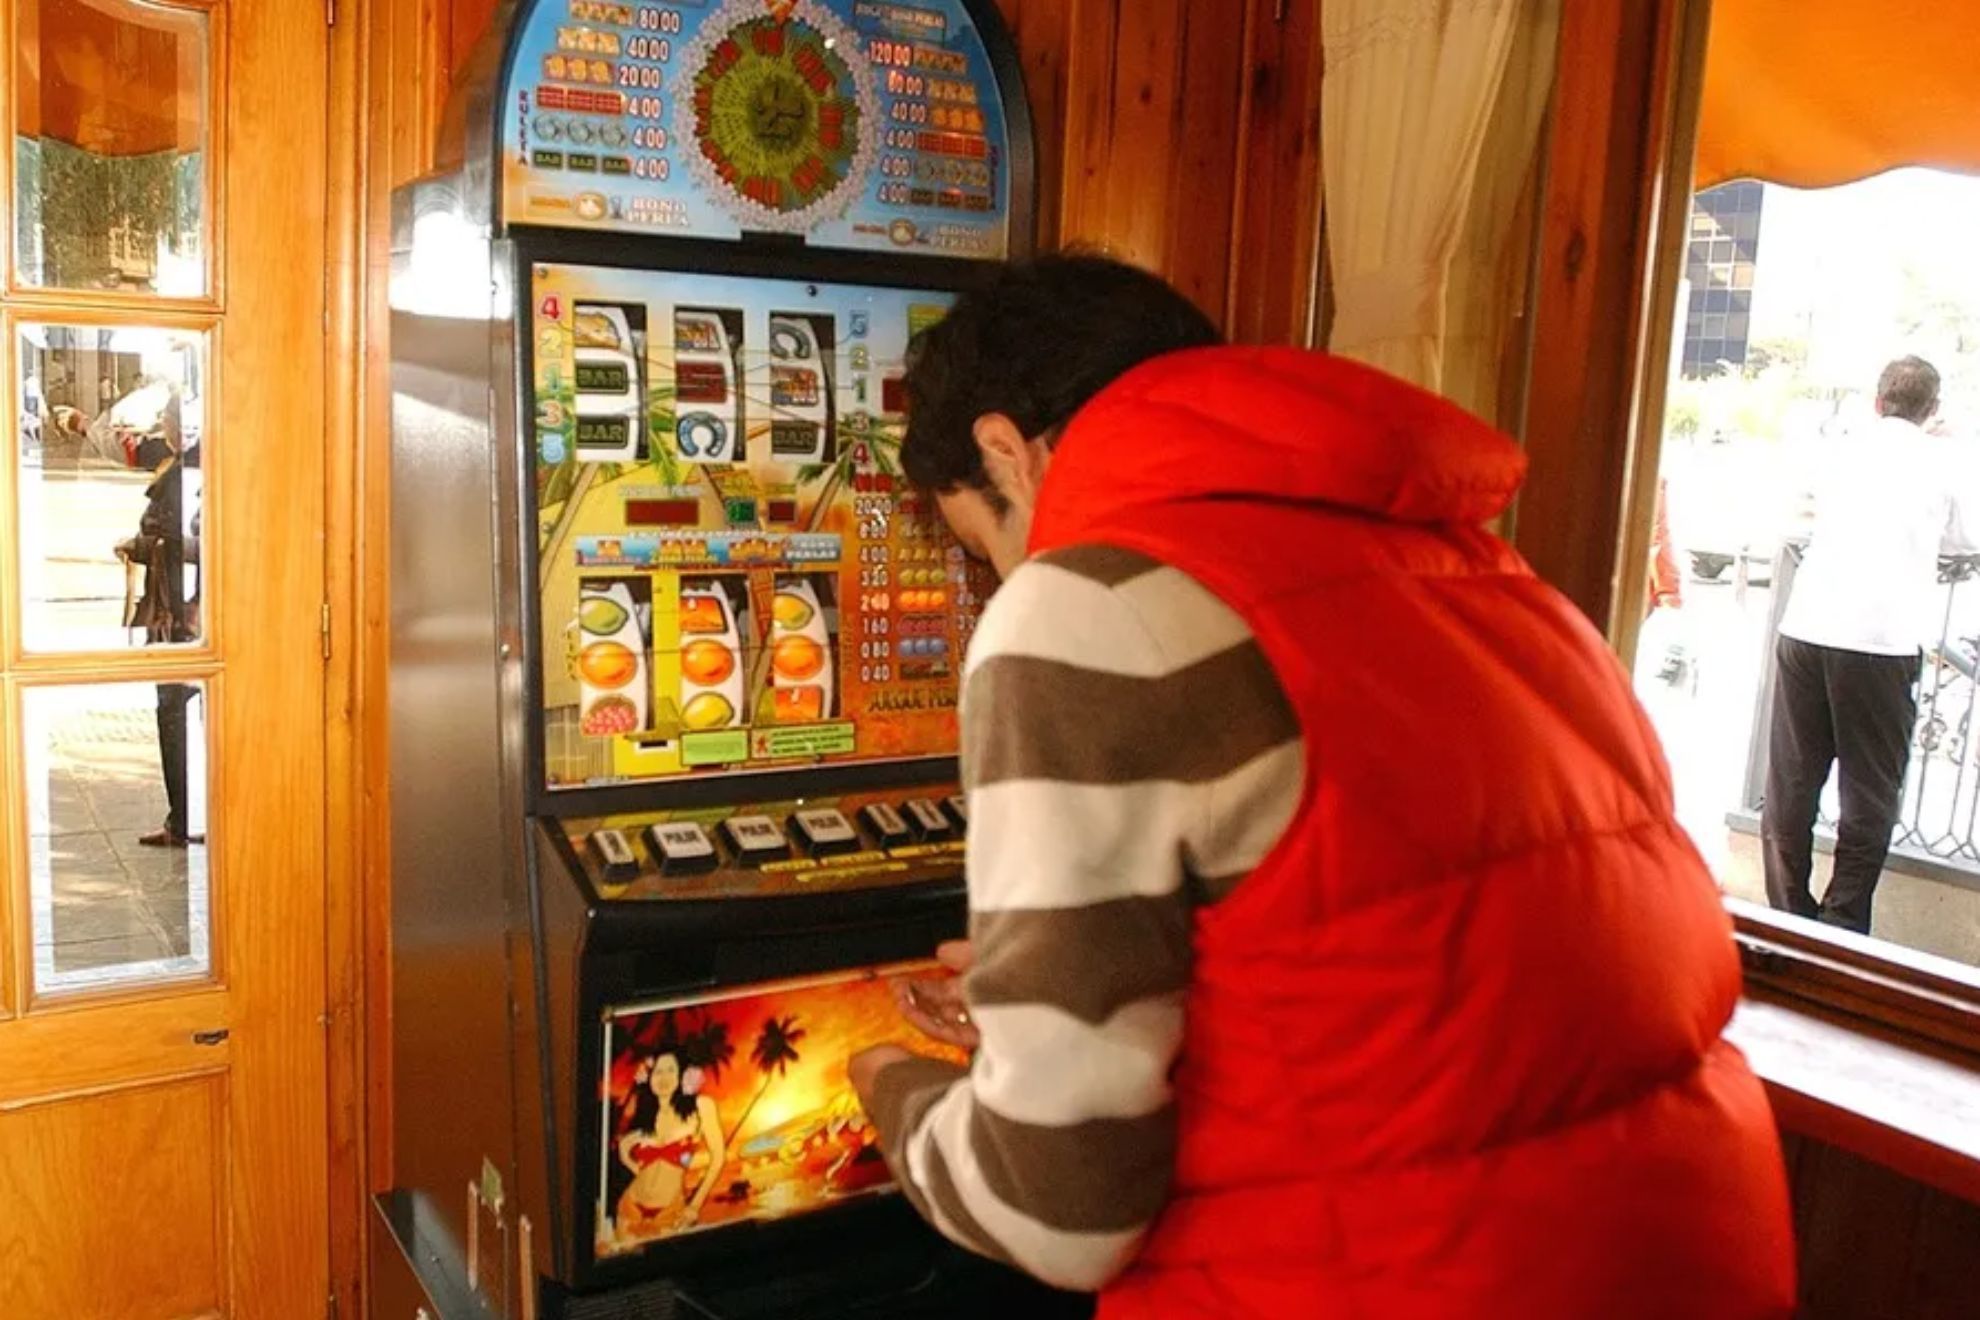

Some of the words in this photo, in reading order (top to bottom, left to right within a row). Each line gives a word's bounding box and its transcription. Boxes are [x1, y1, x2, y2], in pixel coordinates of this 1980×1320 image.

[541, 296, 560, 319] 4
[541, 328, 562, 357] 2
[579, 369, 623, 390] BAR
[544, 401, 561, 425] 3
[580, 423, 624, 442] BAR
[852, 441, 868, 465] 4
